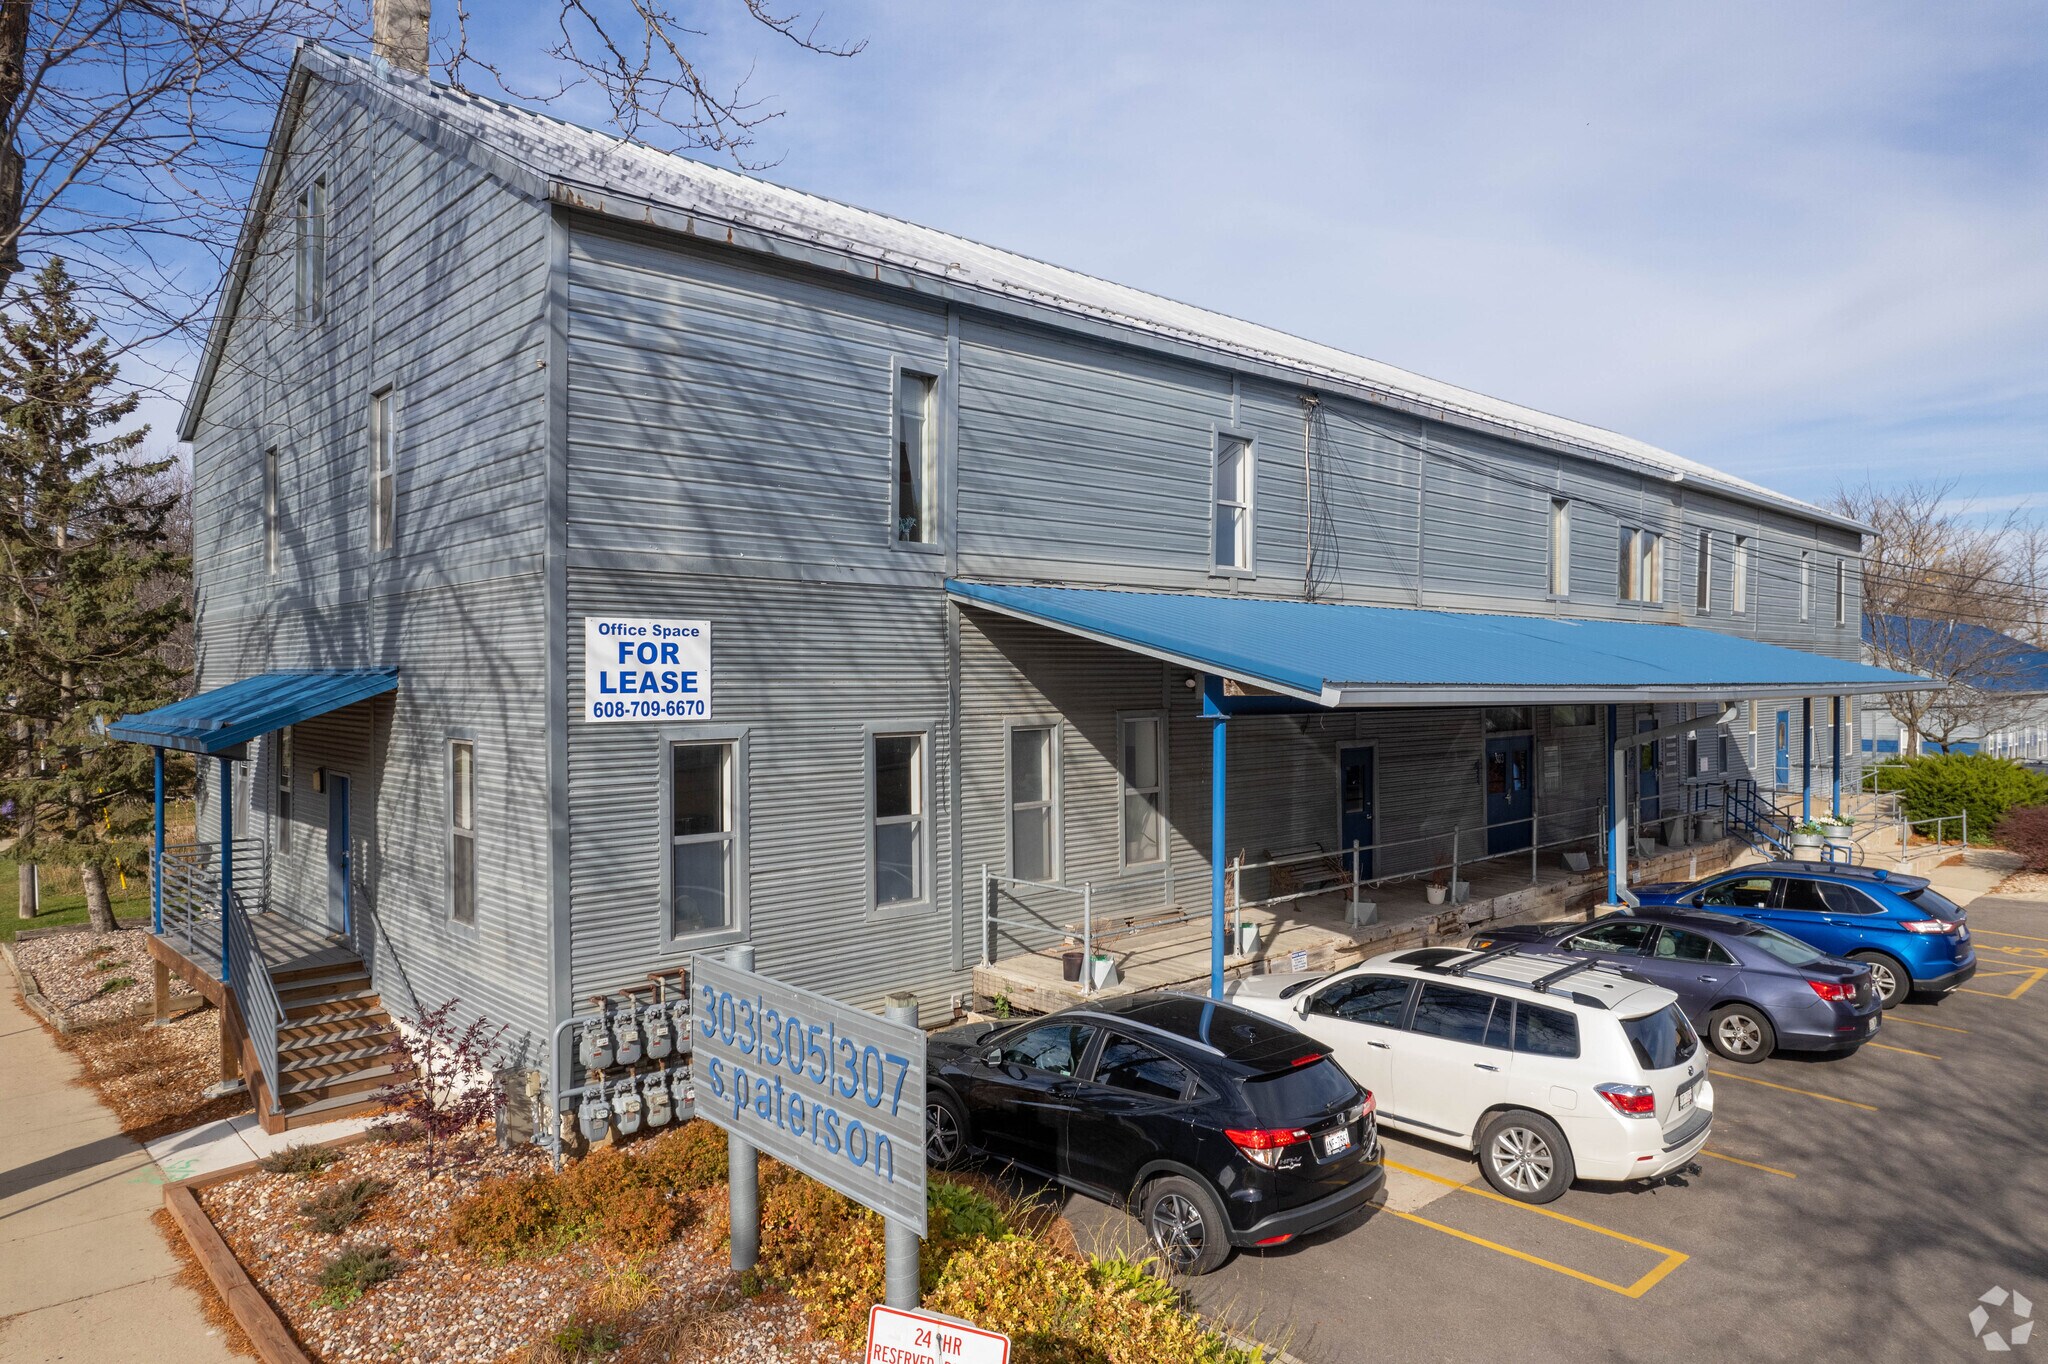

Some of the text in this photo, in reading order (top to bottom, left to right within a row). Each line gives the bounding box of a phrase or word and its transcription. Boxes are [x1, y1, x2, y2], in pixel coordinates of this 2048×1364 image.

[598, 623, 700, 639] Office Space
[618, 641, 680, 665] FOR
[600, 671, 698, 694] LEASE
[593, 700, 705, 718] 608-709-6670
[914, 1327, 963, 1356] 24 HR
